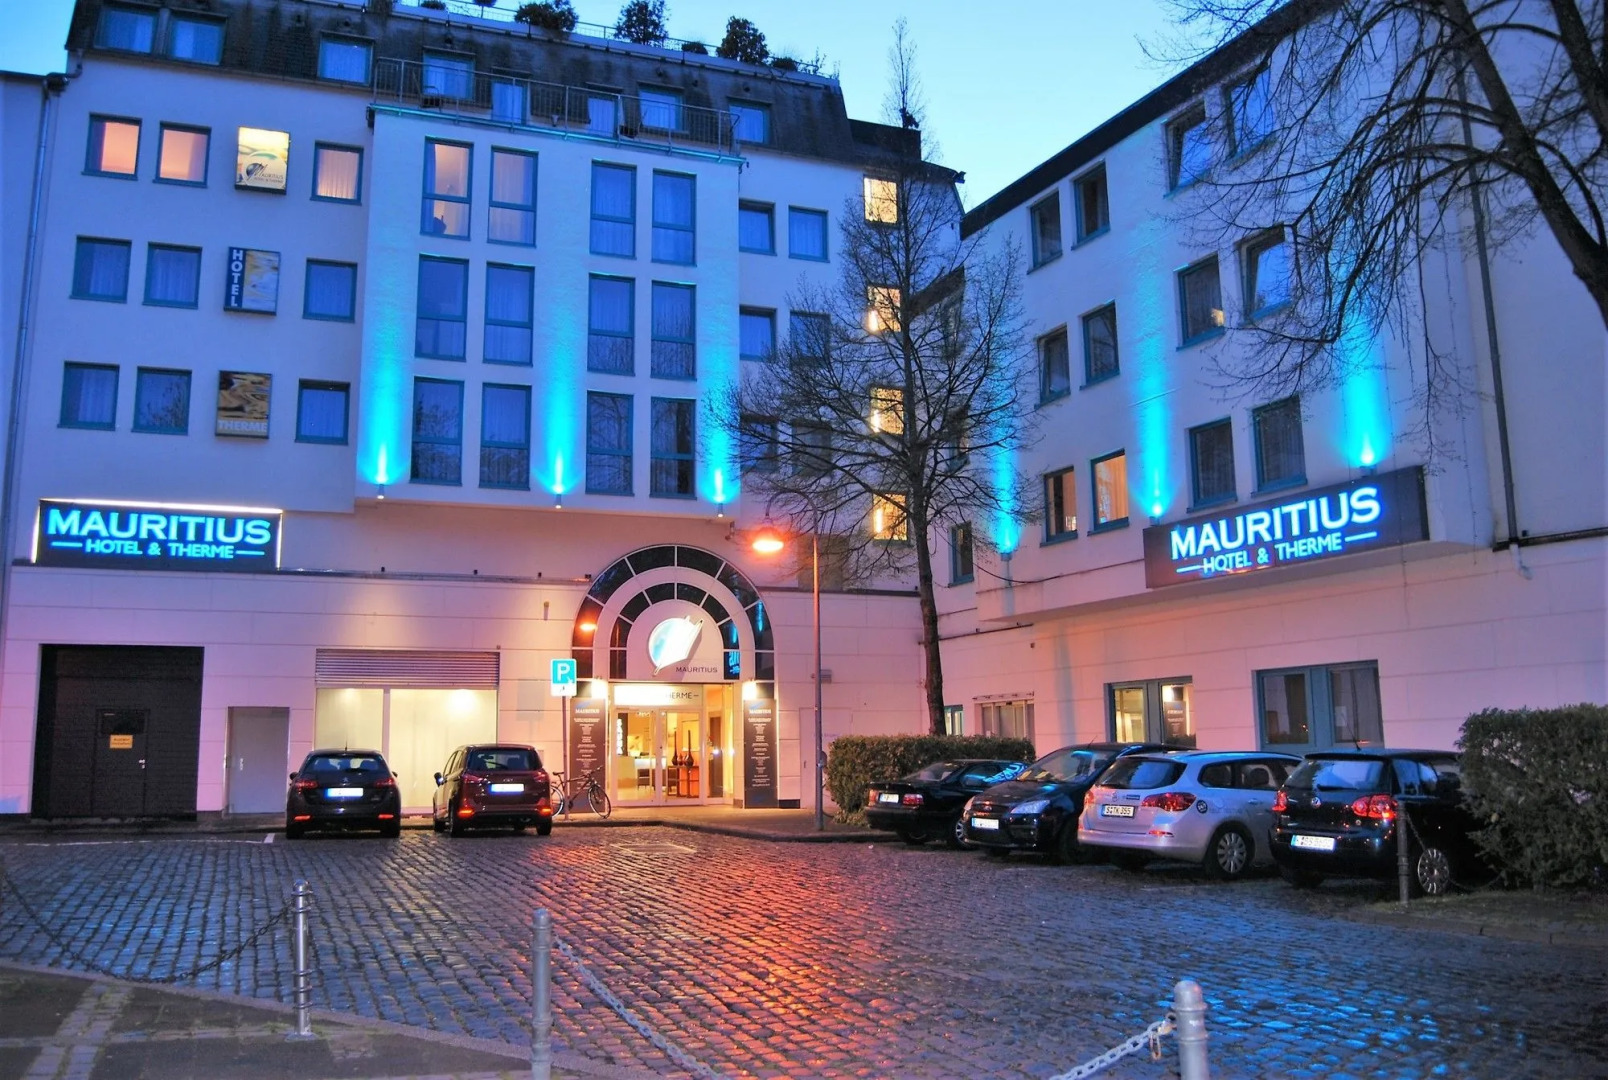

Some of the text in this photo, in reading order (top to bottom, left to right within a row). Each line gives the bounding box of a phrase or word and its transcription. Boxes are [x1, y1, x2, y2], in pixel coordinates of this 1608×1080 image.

[231, 249, 243, 307] HOTEL
[217, 420, 268, 432] THERME
[47, 508, 272, 545] MAURITIUS
[1170, 486, 1382, 560] MAURITIUS
[85, 538, 235, 559] HOTEL & THERME
[1203, 532, 1343, 574] HOTEL & THERME
[557, 662, 570, 682] P
[664, 691, 693, 699] HERME
